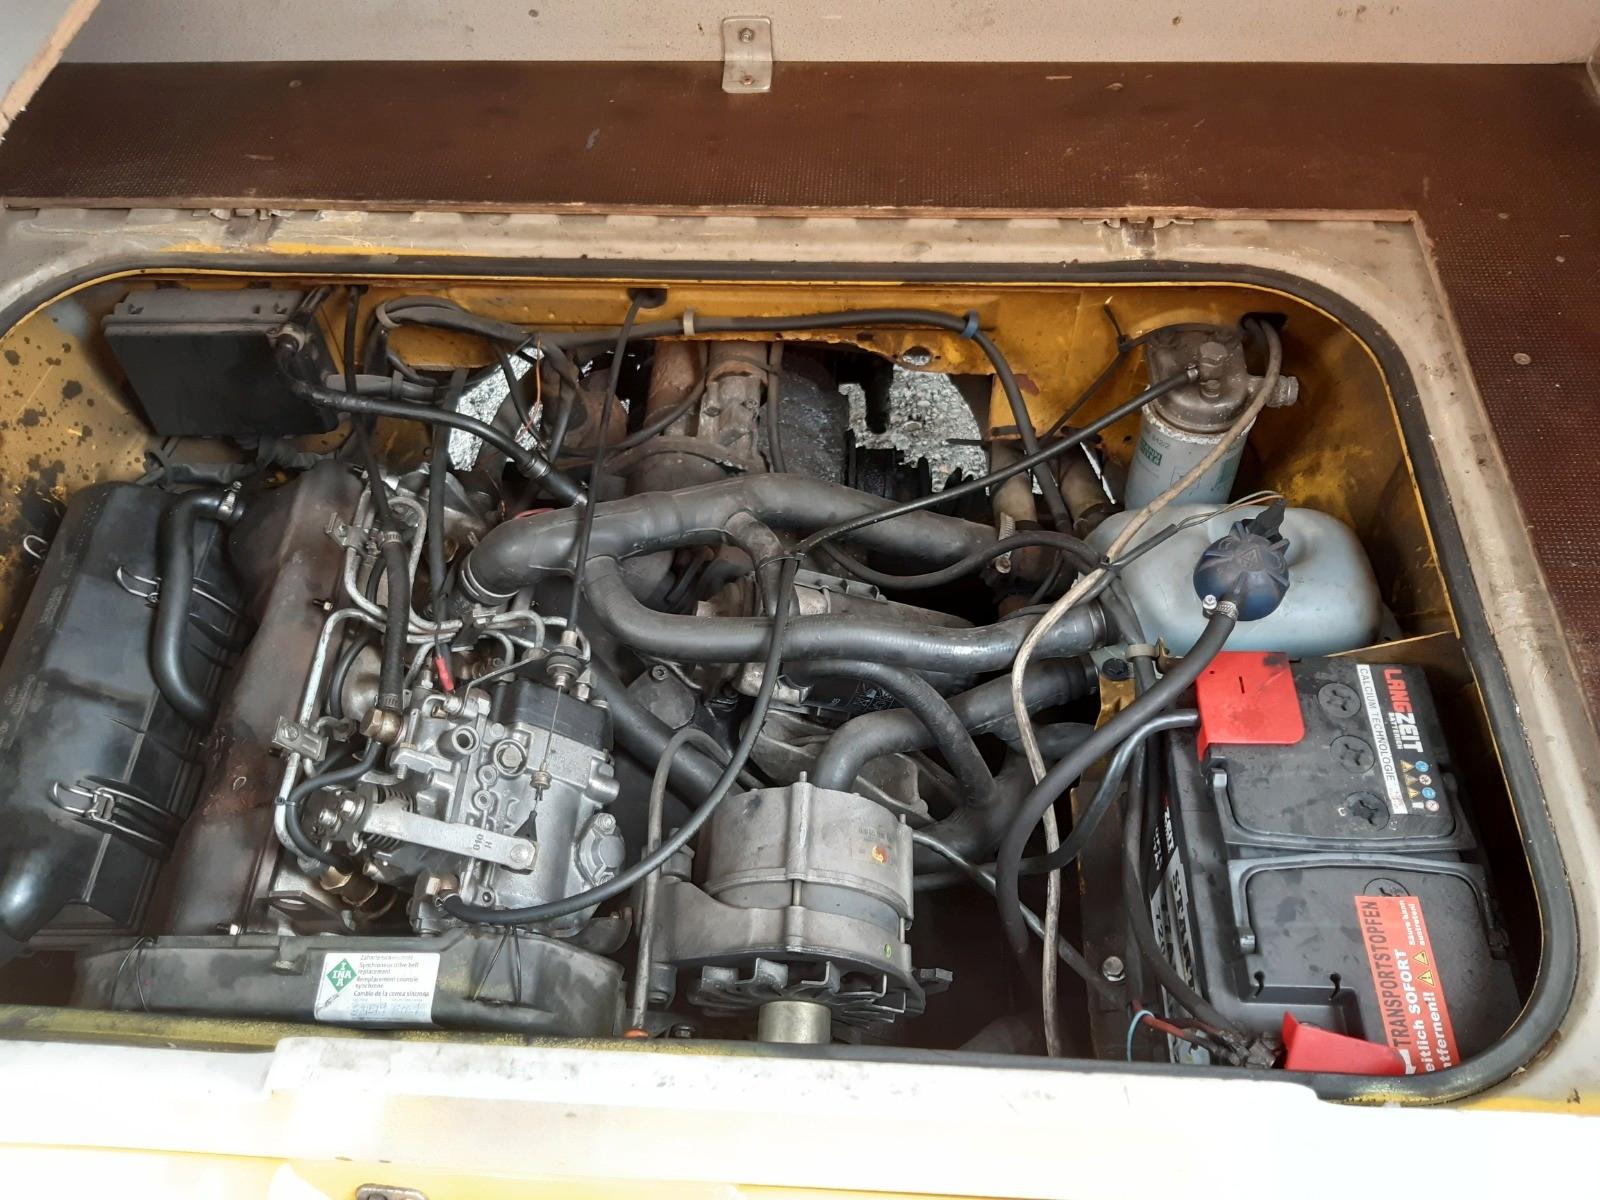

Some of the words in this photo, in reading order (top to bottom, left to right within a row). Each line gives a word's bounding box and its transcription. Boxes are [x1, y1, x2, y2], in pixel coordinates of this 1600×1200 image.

[1360, 668, 1377, 709] CALCIUM
[1371, 712, 1396, 782] TECHNOLOGIE
[1384, 669, 1424, 753] LANGZEIT
[1360, 901, 1411, 1047] TRANSPORTSTOPFEN
[1394, 948, 1421, 1015] SOFORT
[1413, 1020, 1435, 1072] eitlich
[1423, 992, 1452, 1068] tfernen!!
